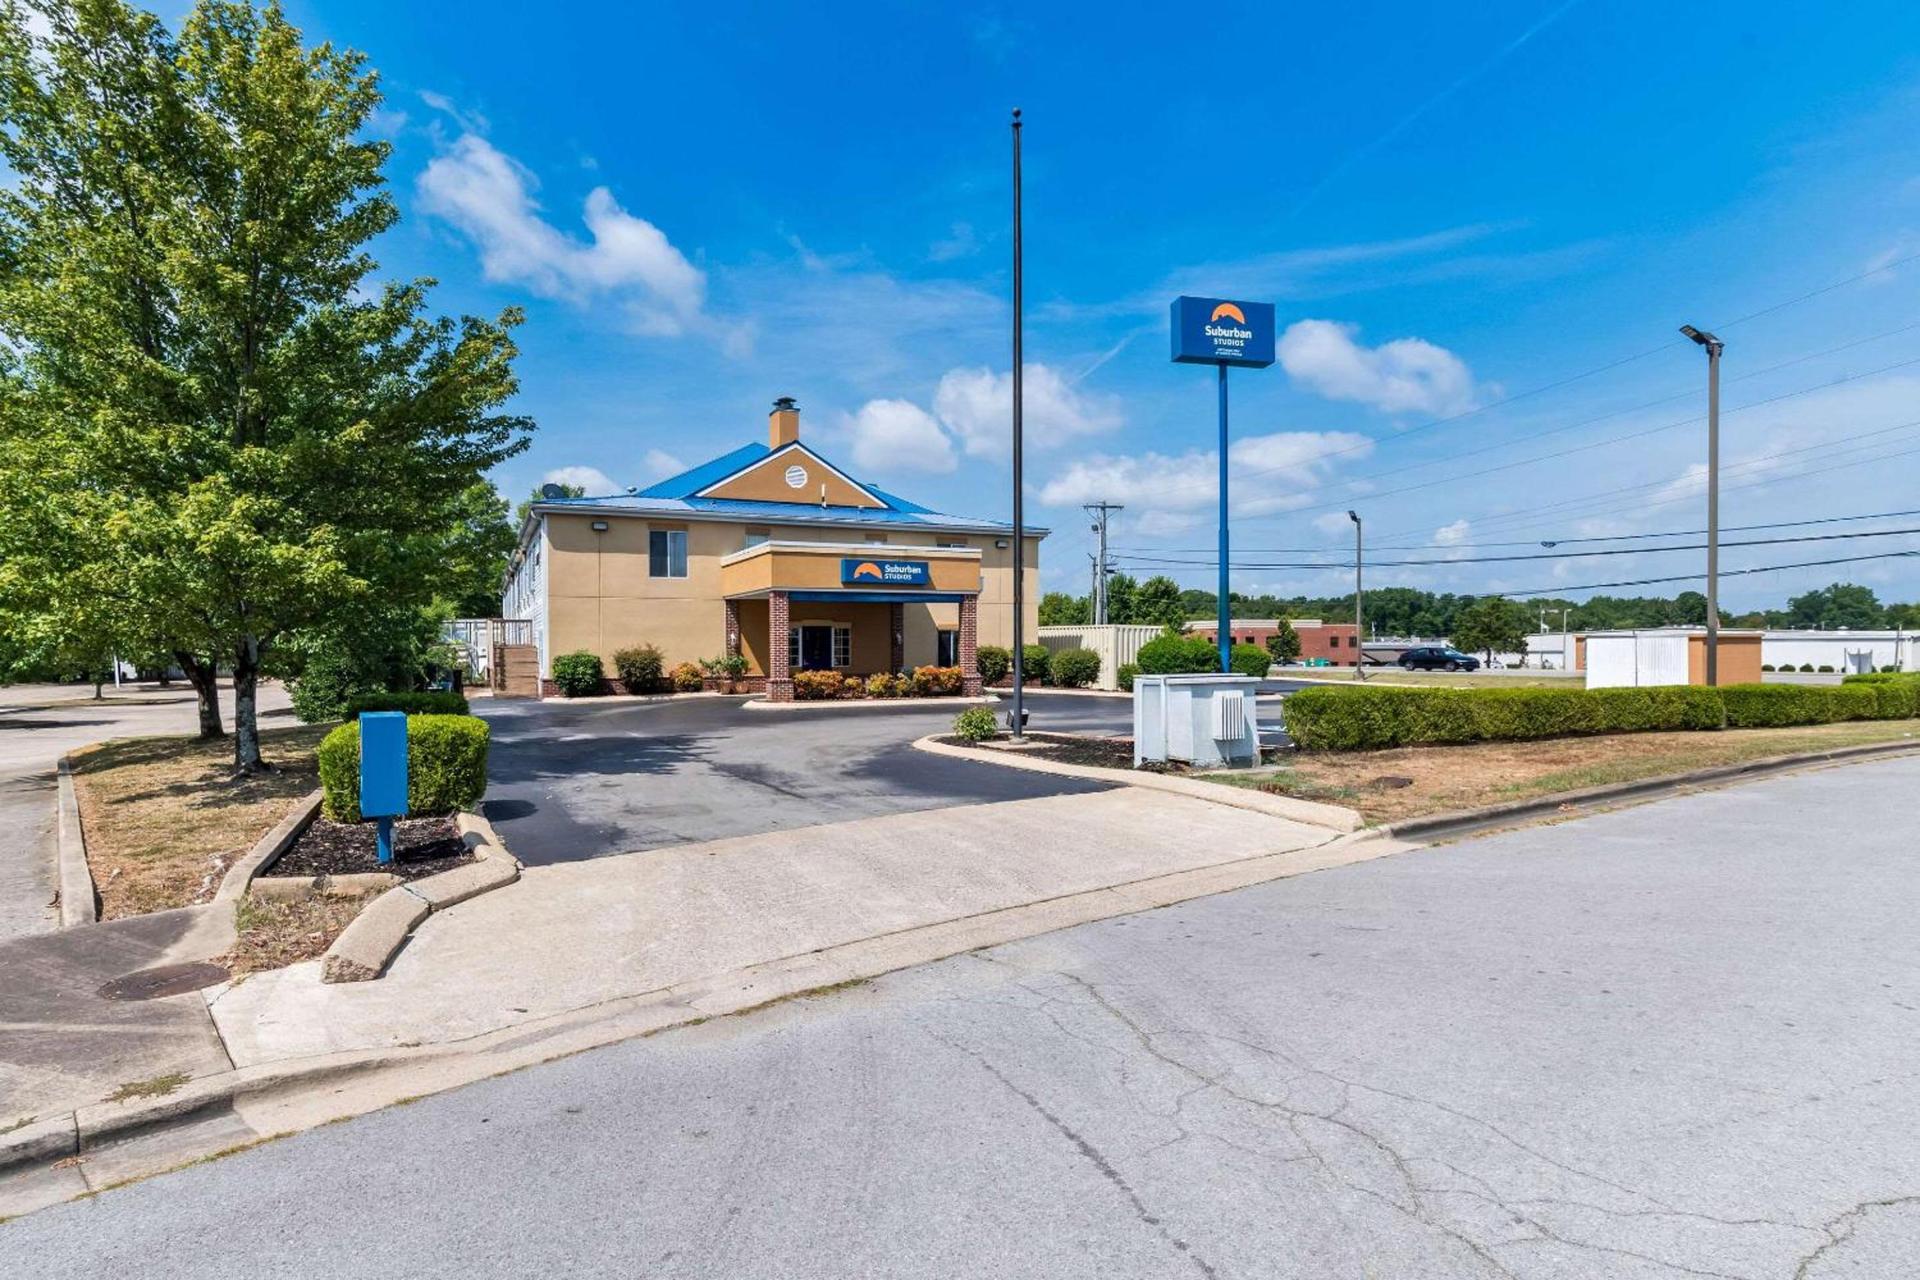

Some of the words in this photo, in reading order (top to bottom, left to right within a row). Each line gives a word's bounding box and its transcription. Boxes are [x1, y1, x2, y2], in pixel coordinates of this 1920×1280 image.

[1205, 325, 1252, 338] Suburban
[1214, 338, 1244, 346] STUDIOS
[884, 564, 921, 574] Suburban
